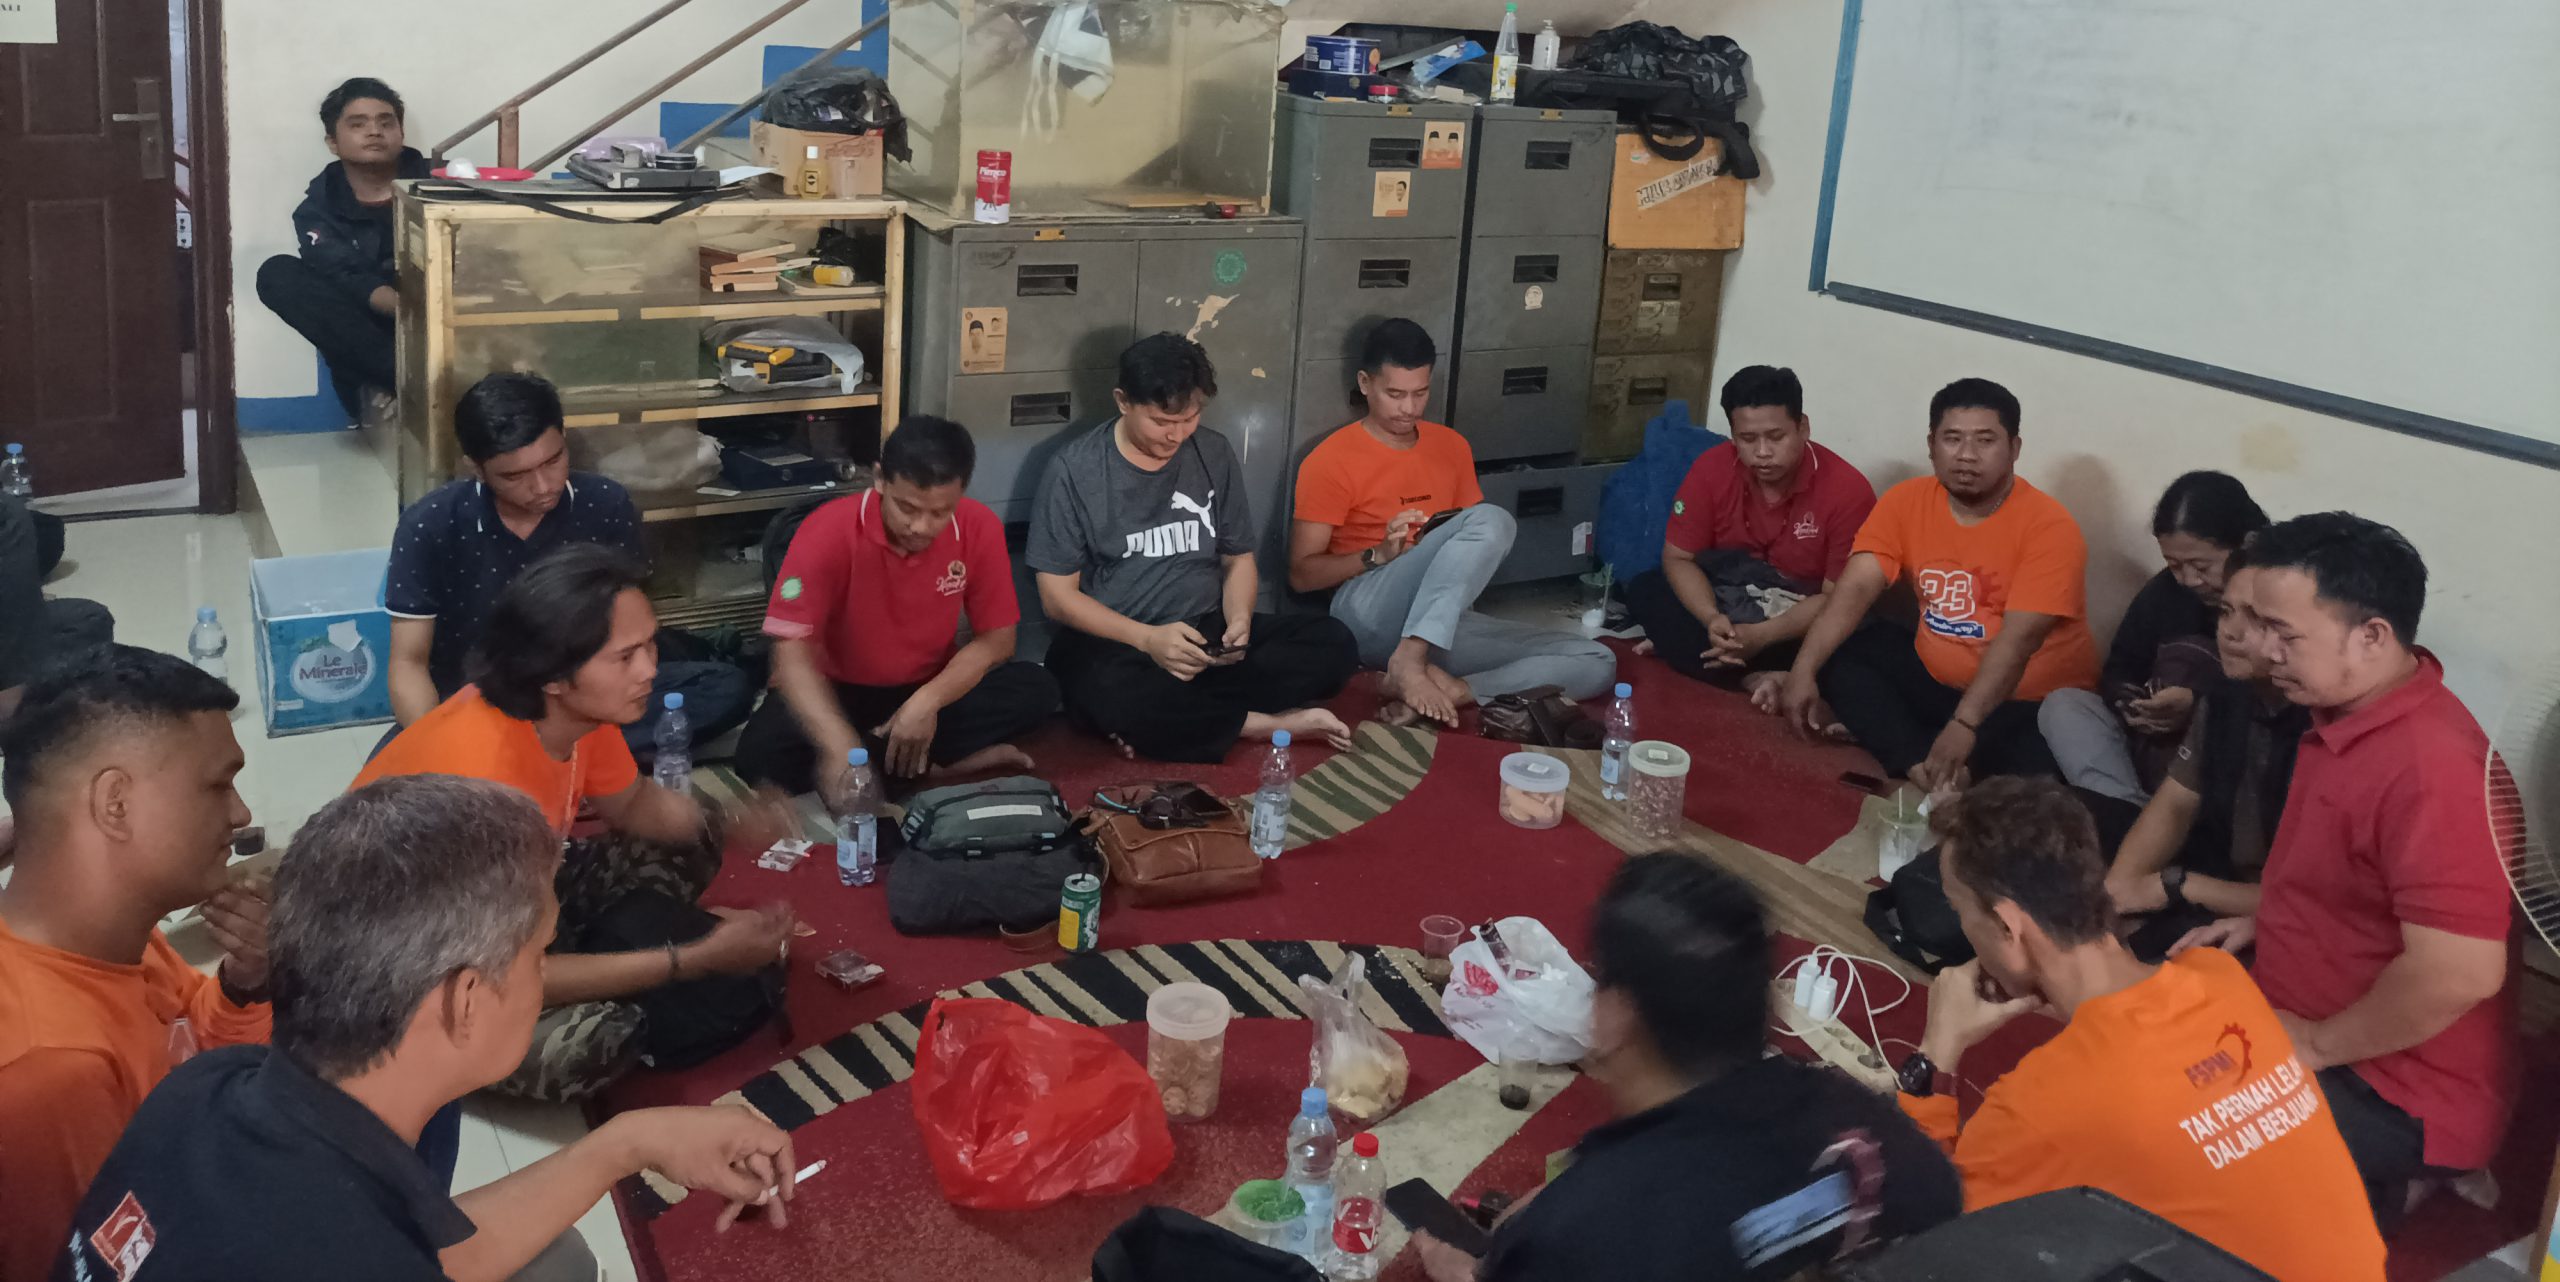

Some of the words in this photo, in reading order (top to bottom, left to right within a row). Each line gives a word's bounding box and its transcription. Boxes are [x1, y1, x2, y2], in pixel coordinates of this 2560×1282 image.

[1122, 520, 1200, 558] PUMA
[299, 663, 368, 680] Minerale
[323, 654, 342, 668] Le
[2178, 1107, 2222, 1144] TAK
[2212, 1076, 2278, 1128] PERNAH
[2203, 1122, 2265, 1169] DALAM
